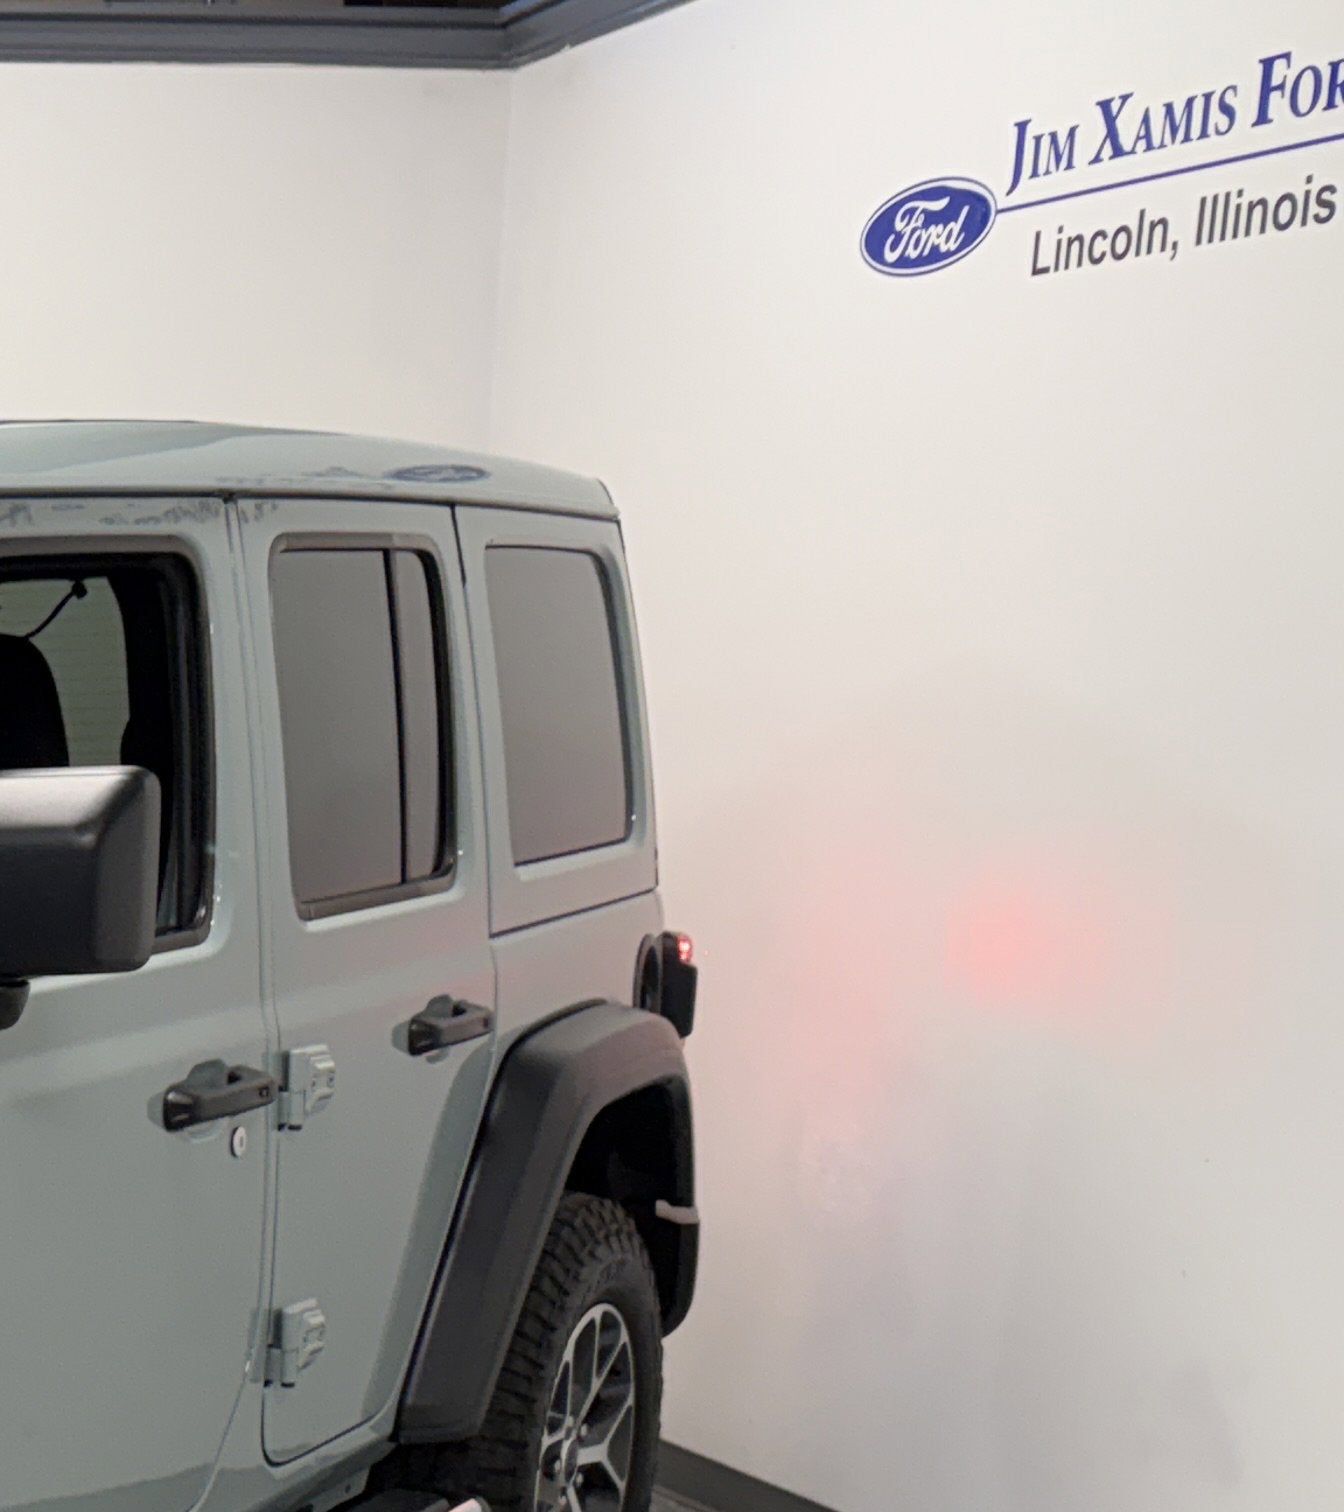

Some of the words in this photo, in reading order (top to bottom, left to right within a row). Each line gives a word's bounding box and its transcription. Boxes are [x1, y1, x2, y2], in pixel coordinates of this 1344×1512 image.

[1006, 119, 1080, 196] JIM
[1088, 84, 1238, 166] XAMIS
[1251, 51, 1344, 128] FOR
[884, 196, 970, 263] Ford
[1031, 208, 1179, 277] Lincoln,
[1194, 174, 1338, 247] Illinois
